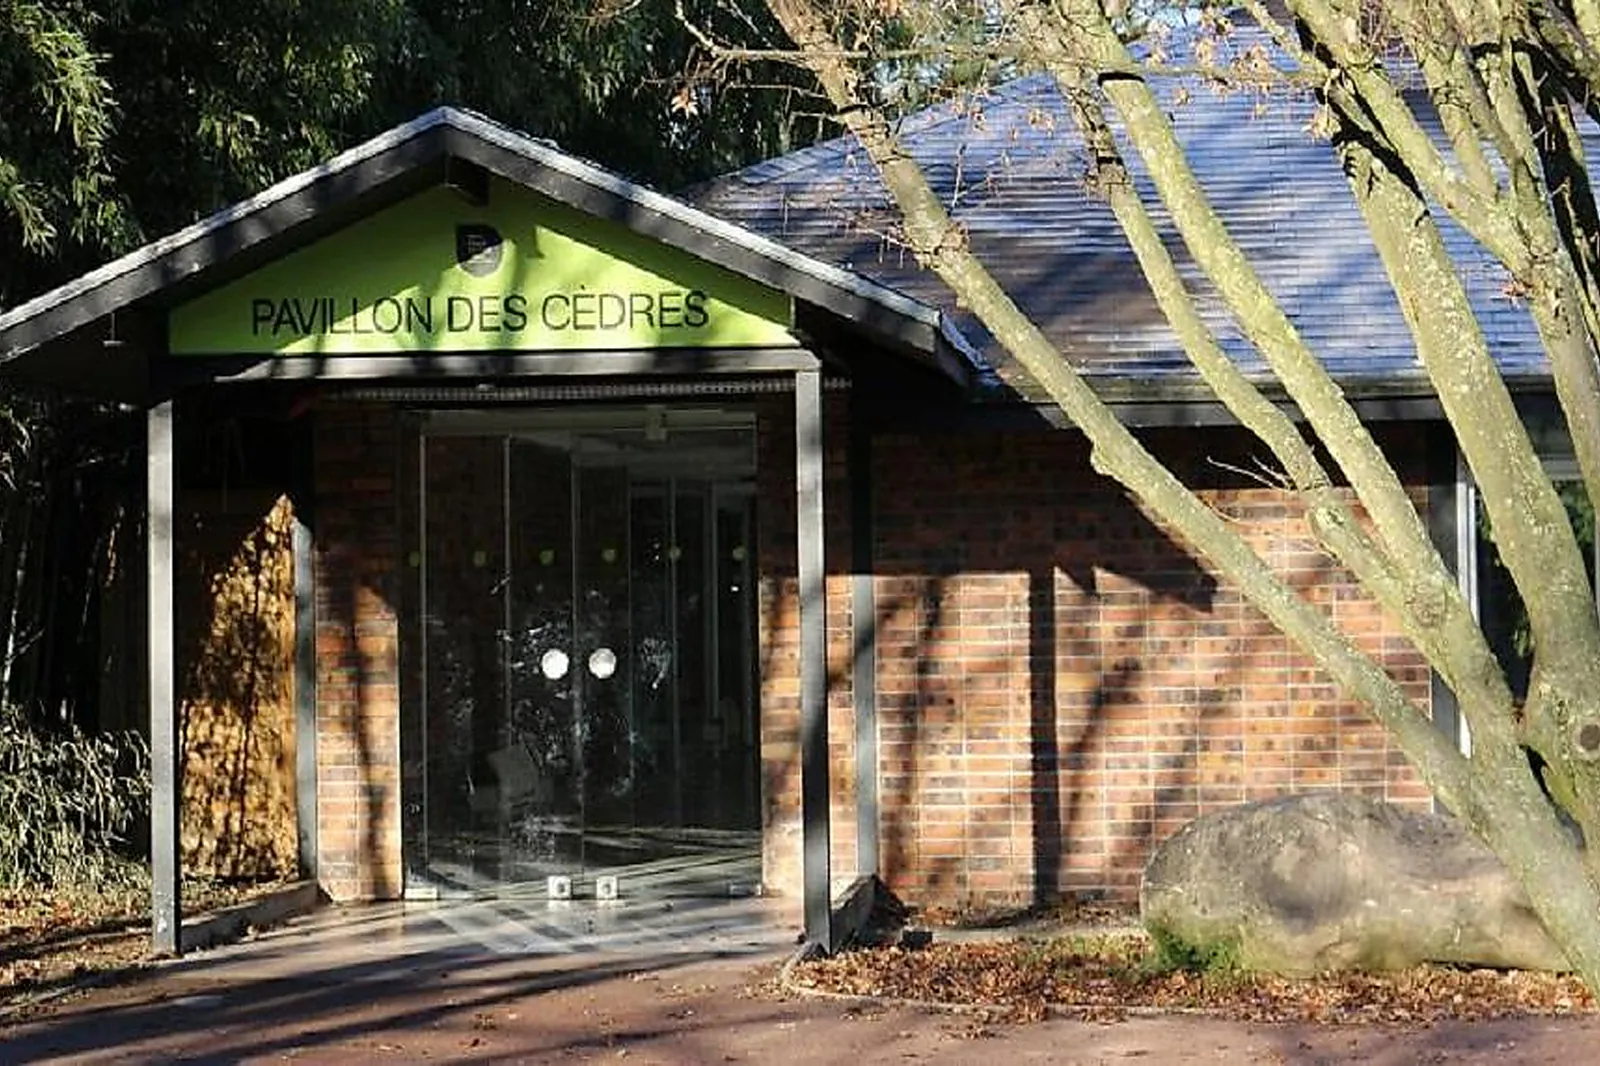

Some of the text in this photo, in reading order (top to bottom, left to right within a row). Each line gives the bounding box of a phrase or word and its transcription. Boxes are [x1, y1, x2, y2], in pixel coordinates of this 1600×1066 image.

[252, 284, 709, 335] PAVILLON DES CÈDRES
